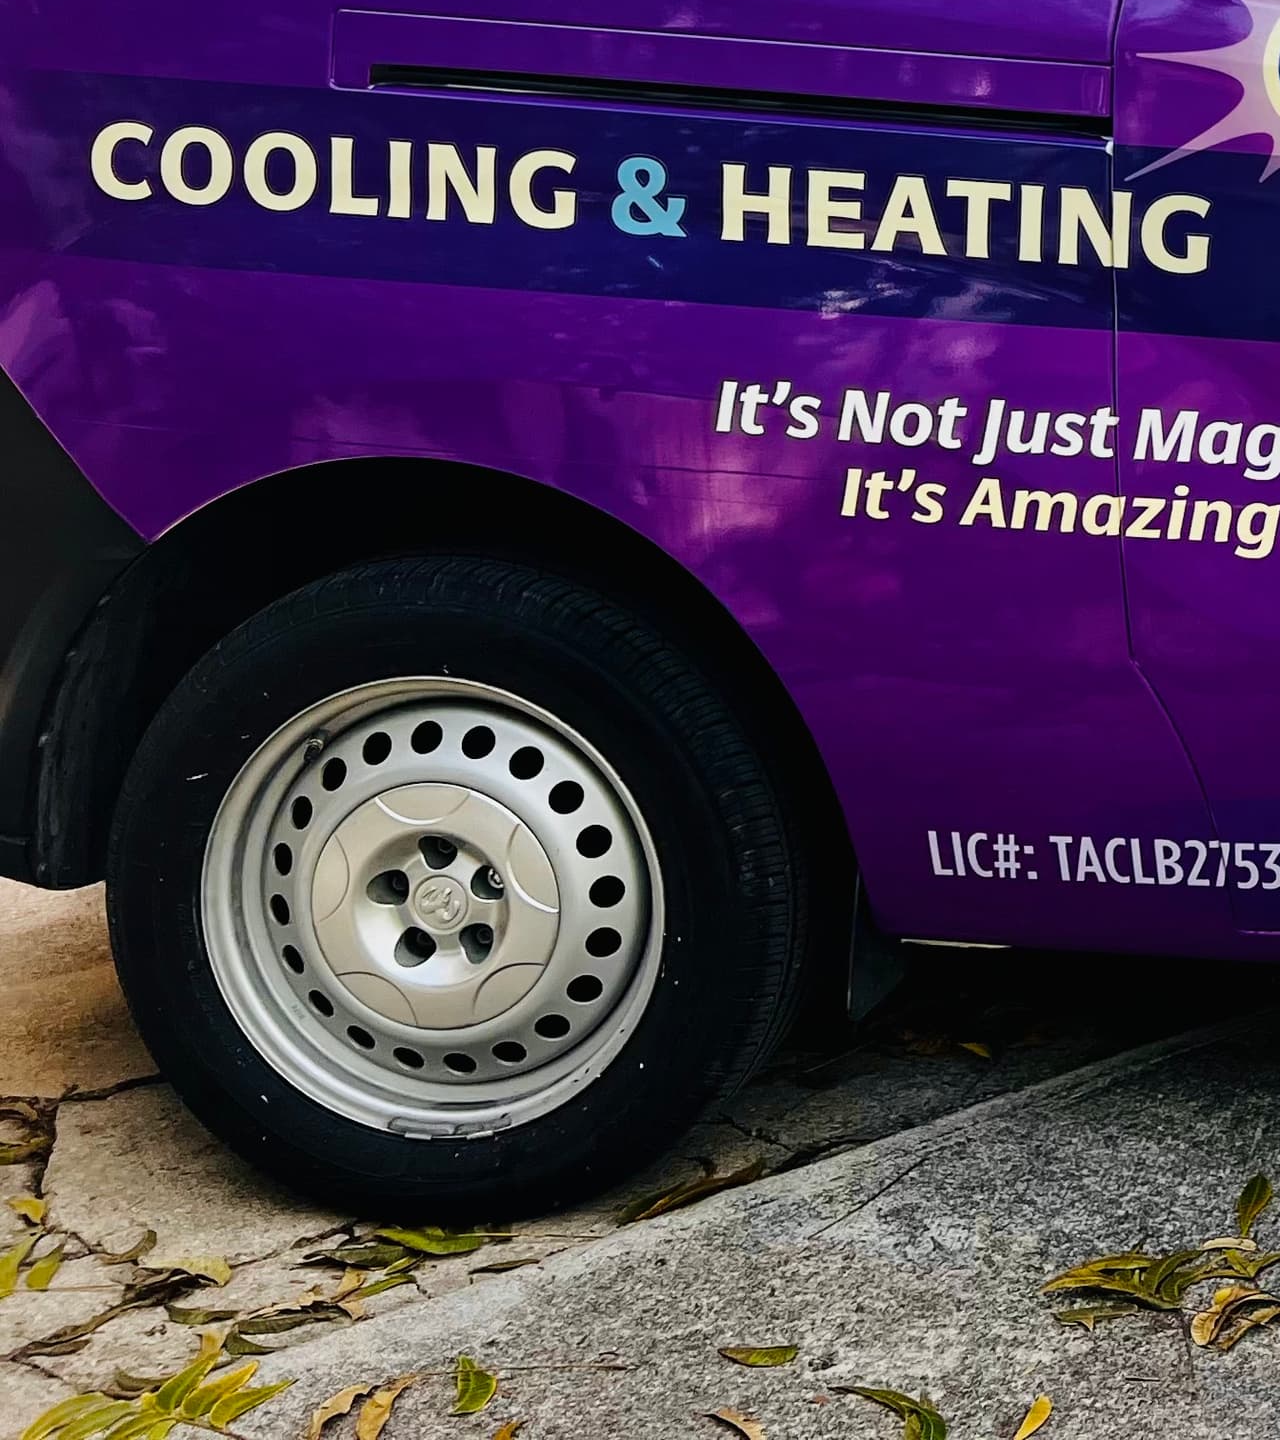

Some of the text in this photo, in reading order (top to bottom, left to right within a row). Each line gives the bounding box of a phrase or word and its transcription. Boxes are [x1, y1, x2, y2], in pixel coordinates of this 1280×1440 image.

[90, 120, 1212, 274] COOLING & HEATING
[836, 389, 968, 450] Not
[972, 398, 1120, 466] Just
[928, 830, 1039, 881] LIC#:
